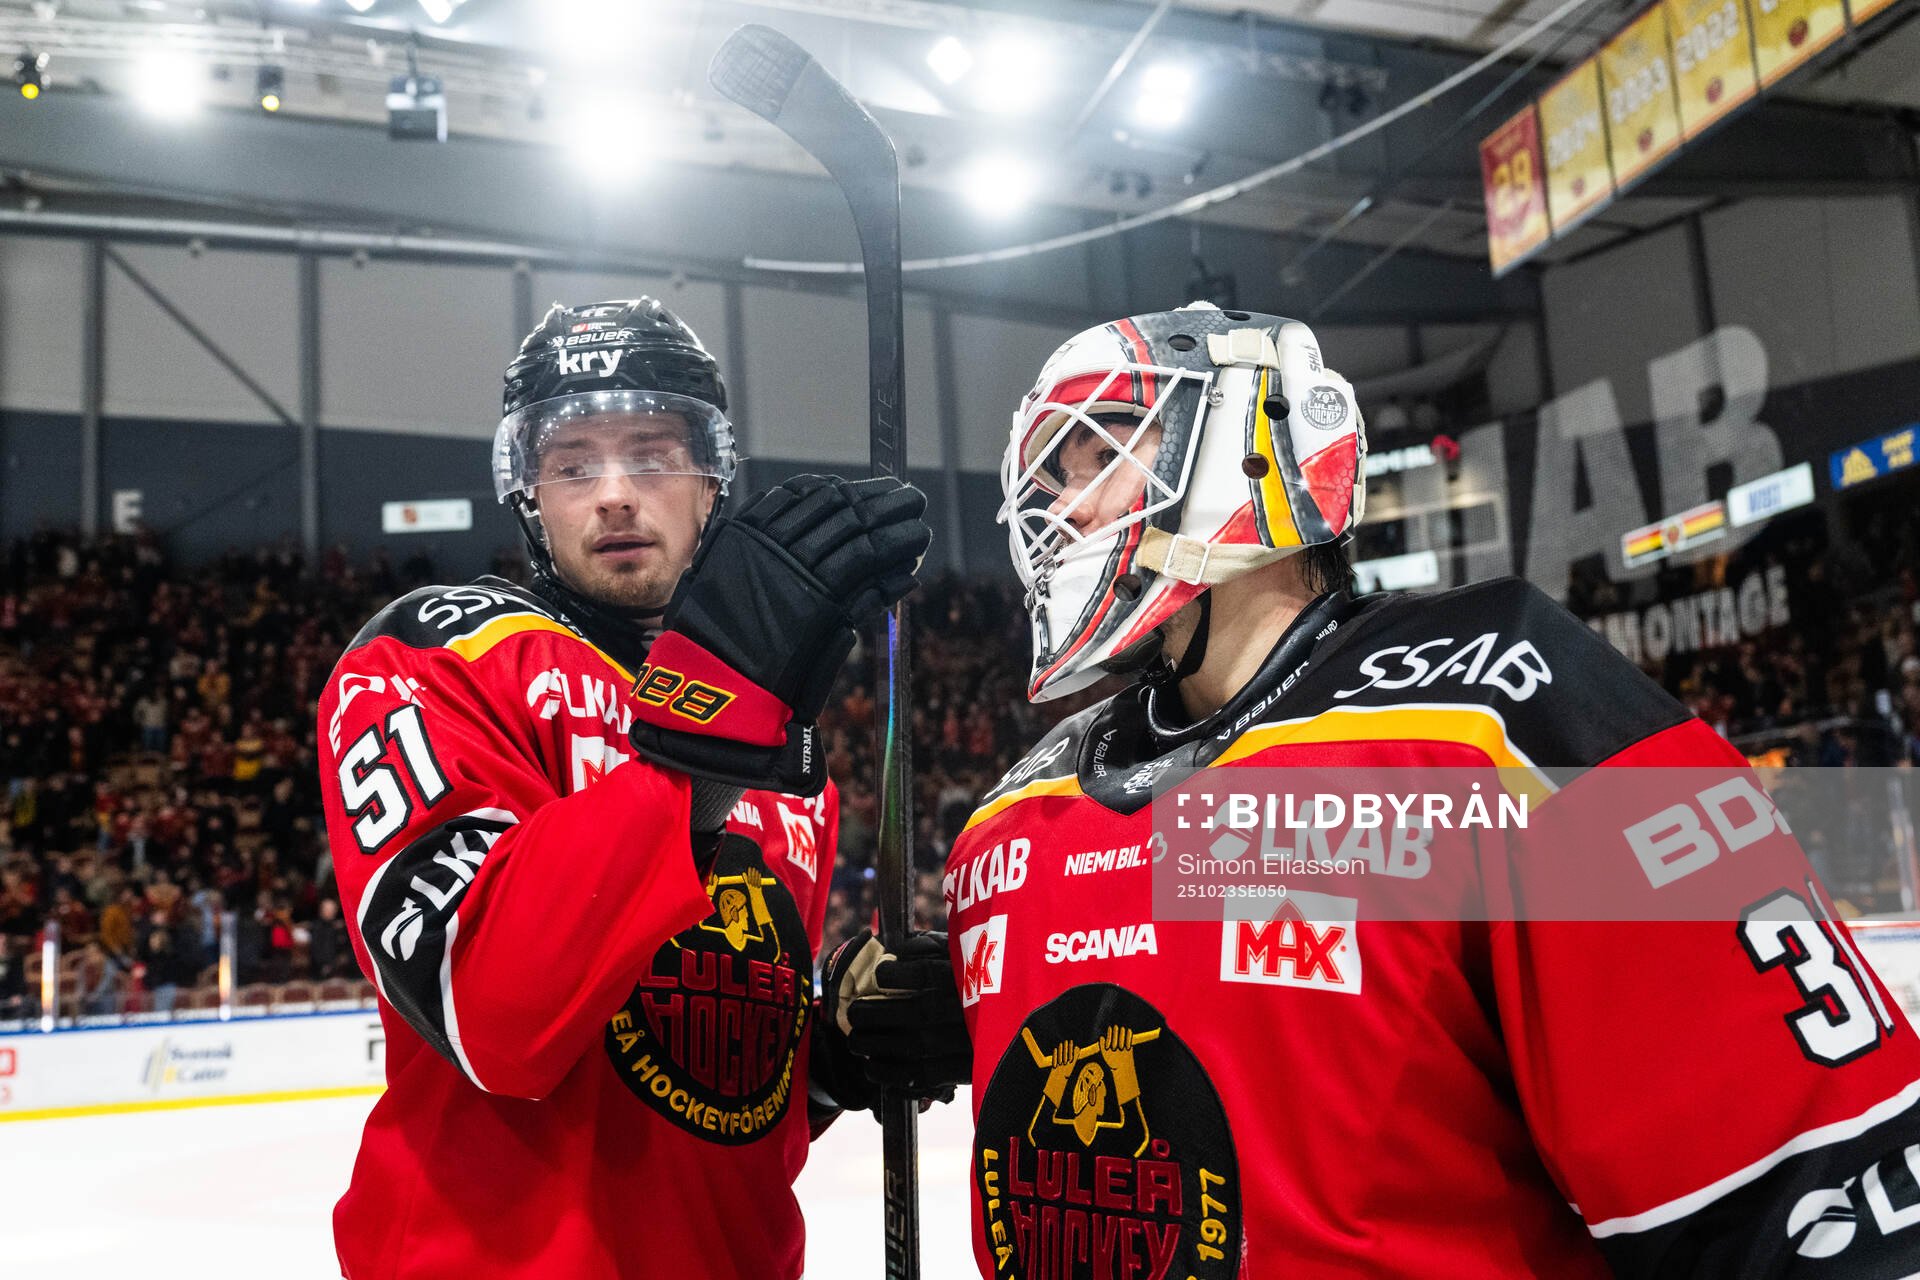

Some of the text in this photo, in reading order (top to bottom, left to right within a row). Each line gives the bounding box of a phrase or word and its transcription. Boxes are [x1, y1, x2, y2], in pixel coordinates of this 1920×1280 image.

[558, 348, 624, 378] kry
[1587, 565, 1791, 665] MONTAGE
[1333, 632, 1553, 702] SSAB
[338, 703, 454, 856] 51
[802, 725, 814, 774] NURMI
[956, 837, 1031, 914] LKAB
[1064, 848, 1113, 877] NIEMI
[1260, 798, 1435, 880] LKAB
[1045, 923, 1158, 965] SCANIA
[1234, 898, 1347, 984] MAX
[640, 992, 793, 1097] HOCKEY
[1009, 1136, 1183, 1217] LULEÅ
[1195, 1167, 1228, 1262] 1977
